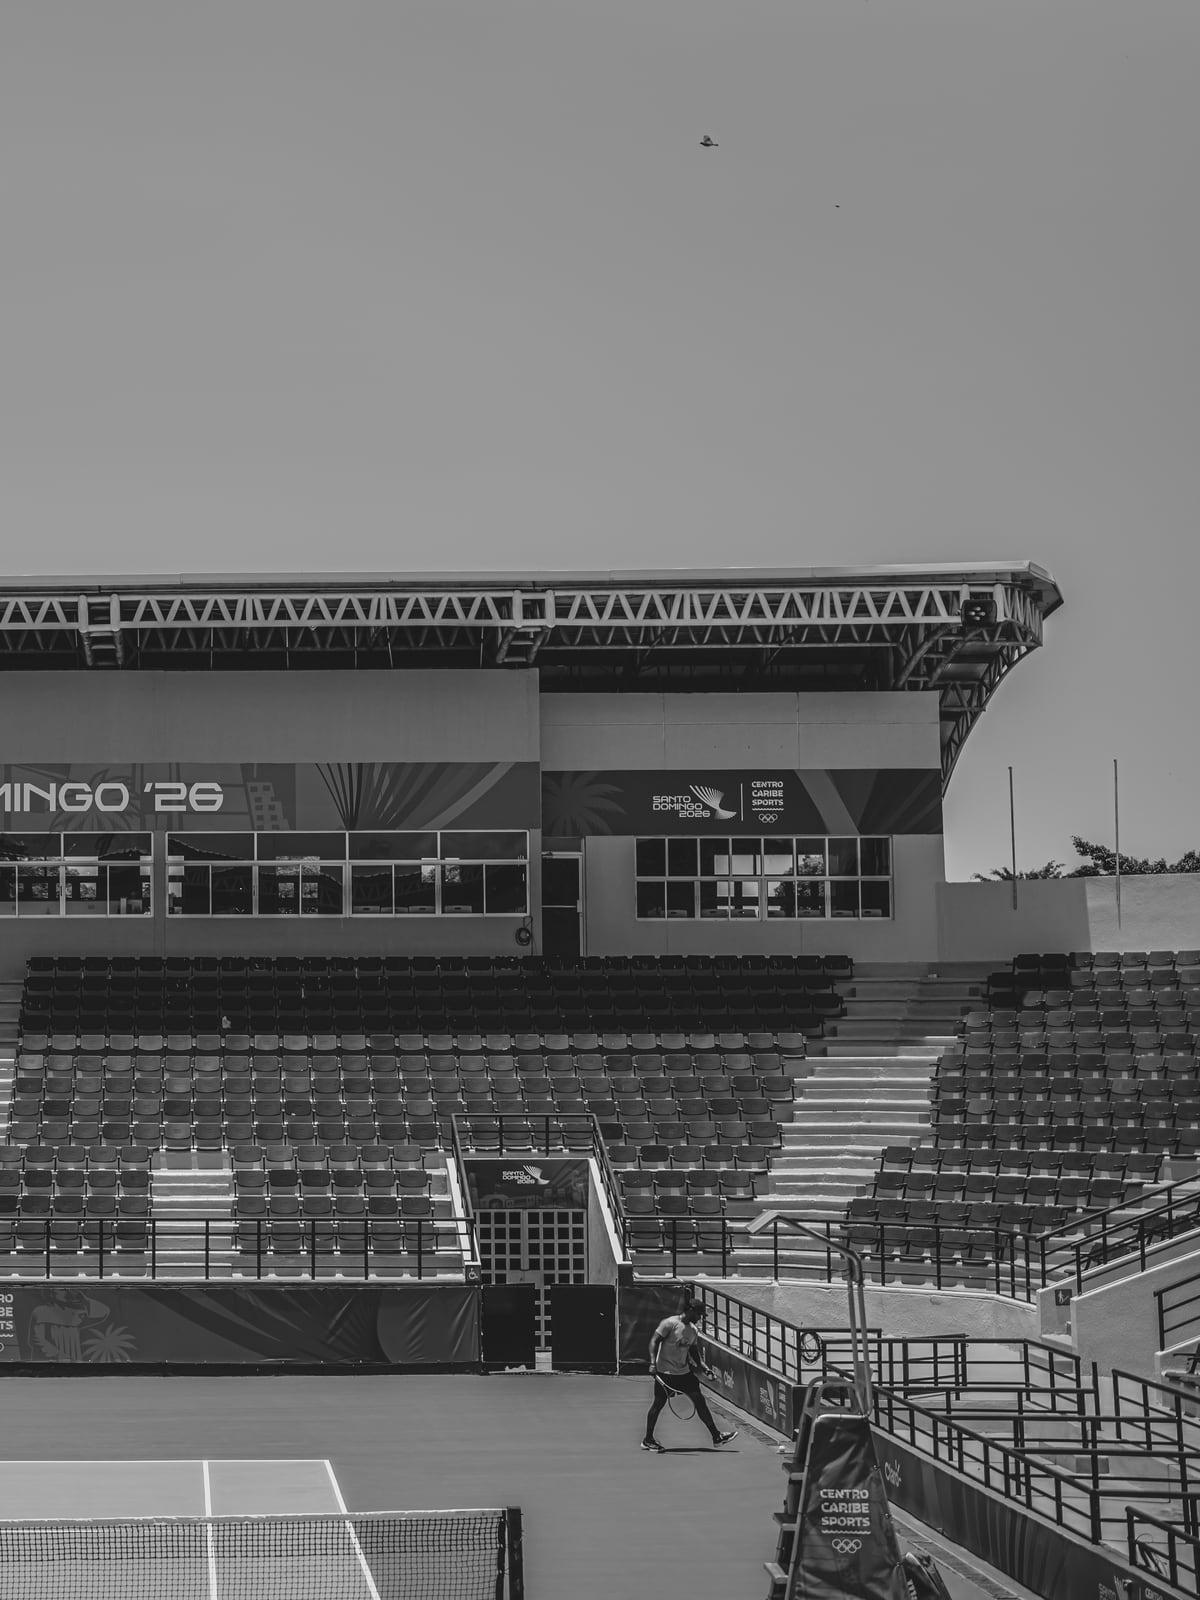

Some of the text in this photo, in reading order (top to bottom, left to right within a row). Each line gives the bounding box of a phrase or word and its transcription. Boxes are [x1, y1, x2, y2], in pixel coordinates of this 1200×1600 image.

[751, 789, 783, 797] CARIBE
[652, 795, 691, 803] SANTO
[652, 803, 703, 811] DOMINGO
[679, 810, 711, 818] 2026
[820, 1488, 869, 1499] CENTRO
[821, 1502, 870, 1513] CARIBE
[821, 1516, 870, 1527] SPORTS
